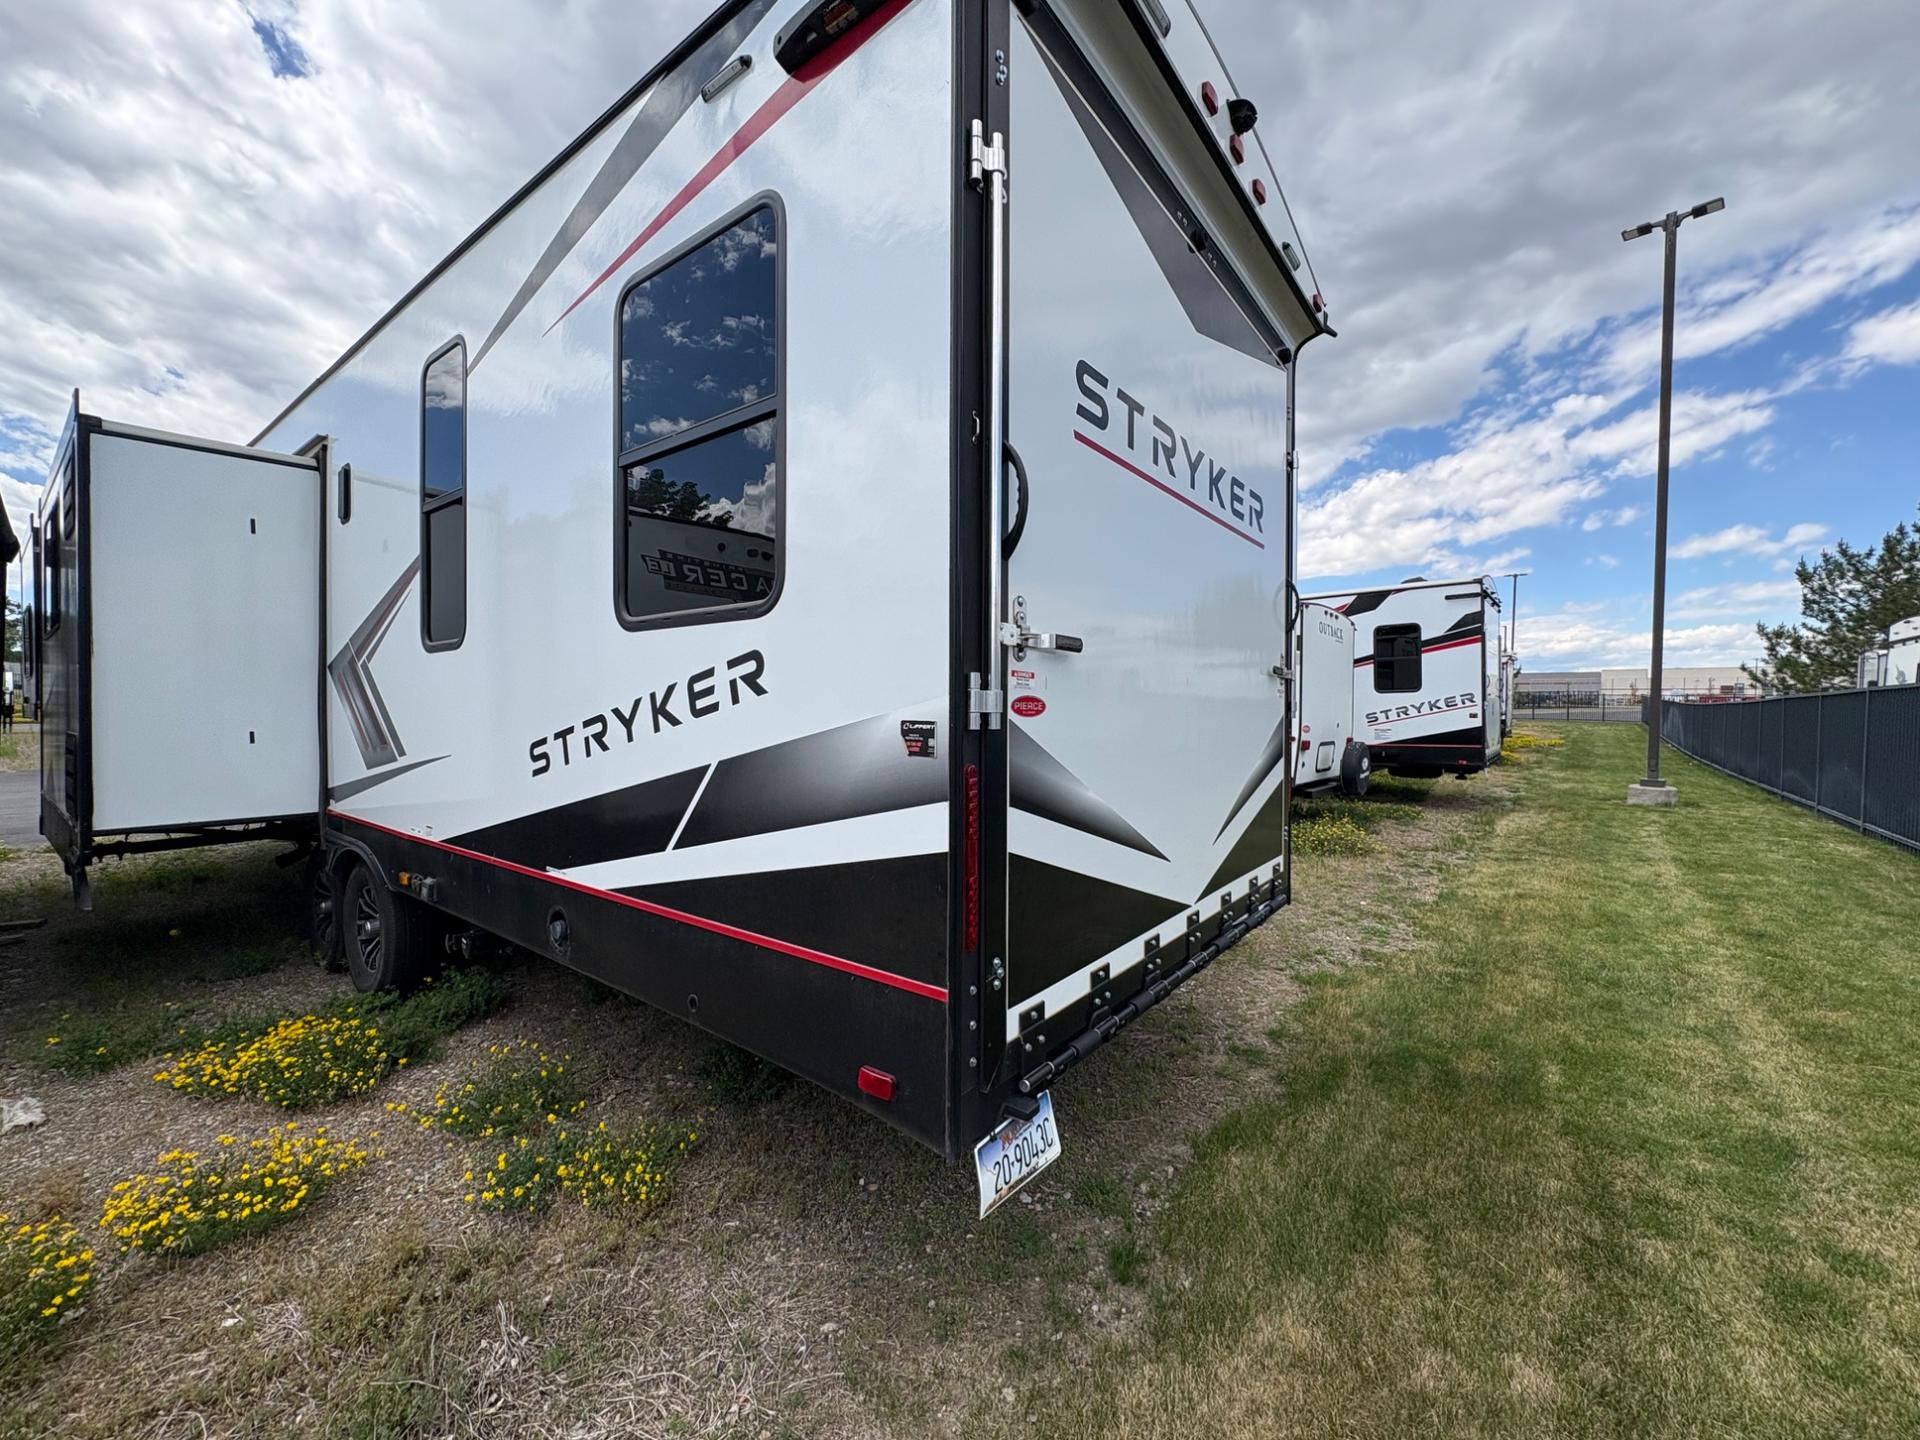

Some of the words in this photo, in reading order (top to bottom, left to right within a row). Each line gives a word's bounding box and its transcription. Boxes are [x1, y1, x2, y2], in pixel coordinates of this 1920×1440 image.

[1076, 359, 1264, 534] STRYKER
[1318, 621, 1344, 640] OUTBACK
[529, 649, 769, 778] STRYKER
[1014, 701, 1044, 711] PIERCE
[1365, 692, 1477, 724] STRYKER
